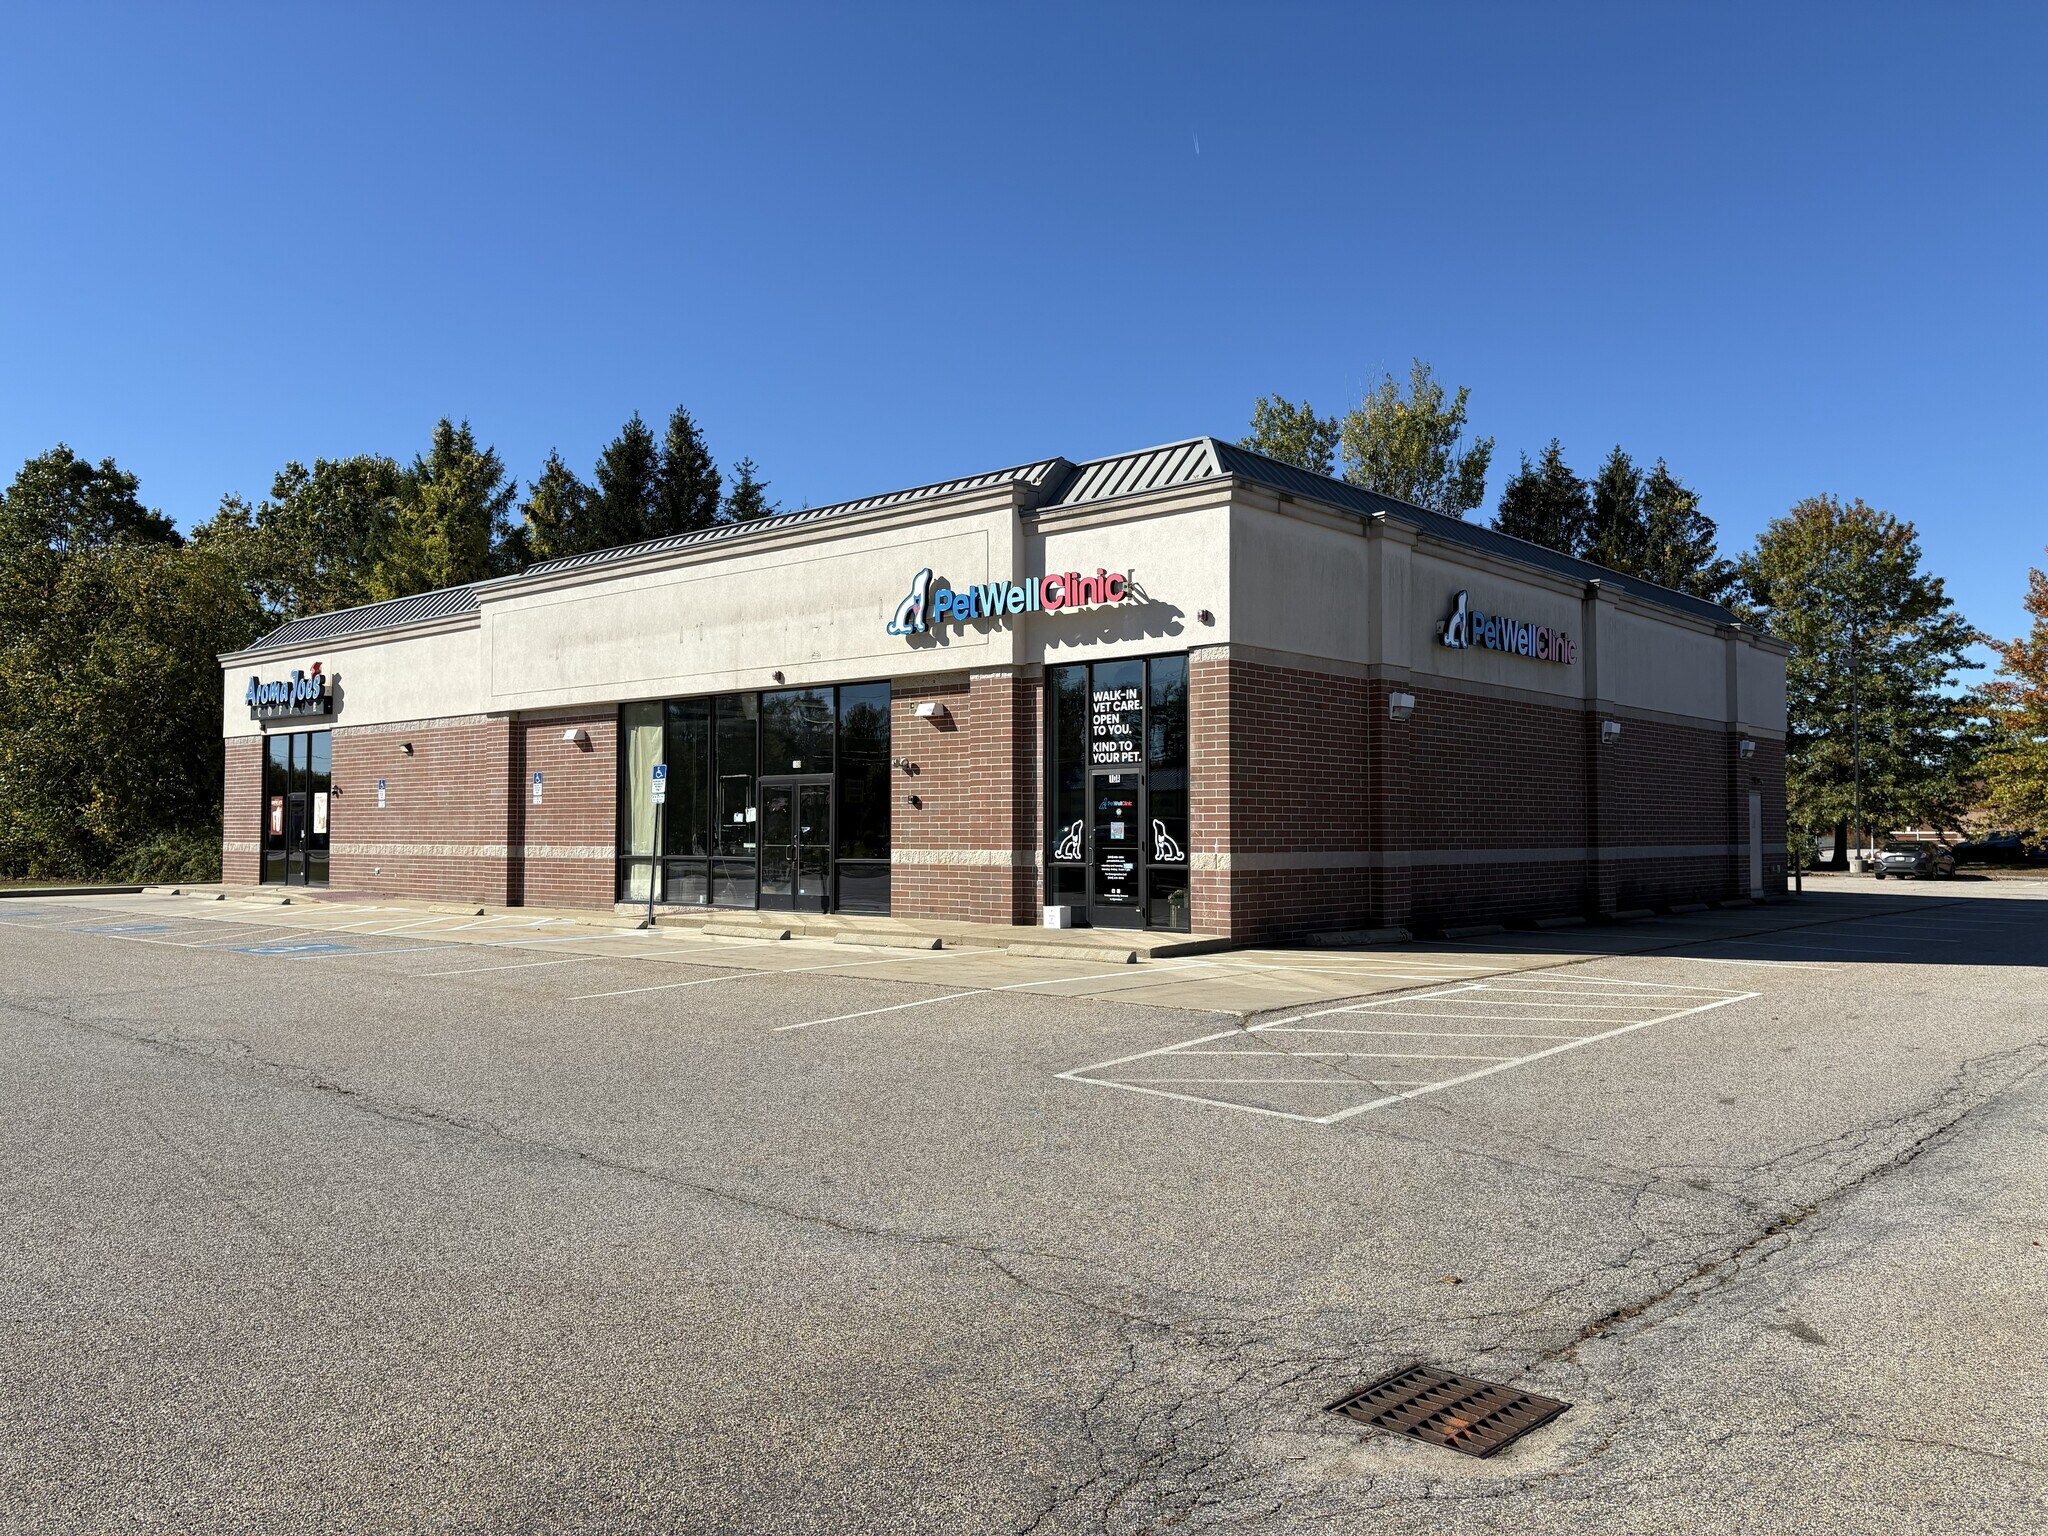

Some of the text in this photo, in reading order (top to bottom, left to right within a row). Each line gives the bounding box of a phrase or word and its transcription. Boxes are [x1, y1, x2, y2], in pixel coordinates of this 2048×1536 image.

[934, 569, 1125, 624] PetWellClinic
[1469, 610, 1577, 665] PetWellClinic
[245, 676, 288, 706] Aroma
[1093, 689, 1137, 702] WALK-IN
[1093, 700, 1143, 713] VET CARE.
[1093, 714, 1120, 725] OPEN
[1093, 724, 1132, 736] TO YOU.
[1093, 741, 1133, 752] KIND TO
[1093, 752, 1142, 763] YOUR PET.
